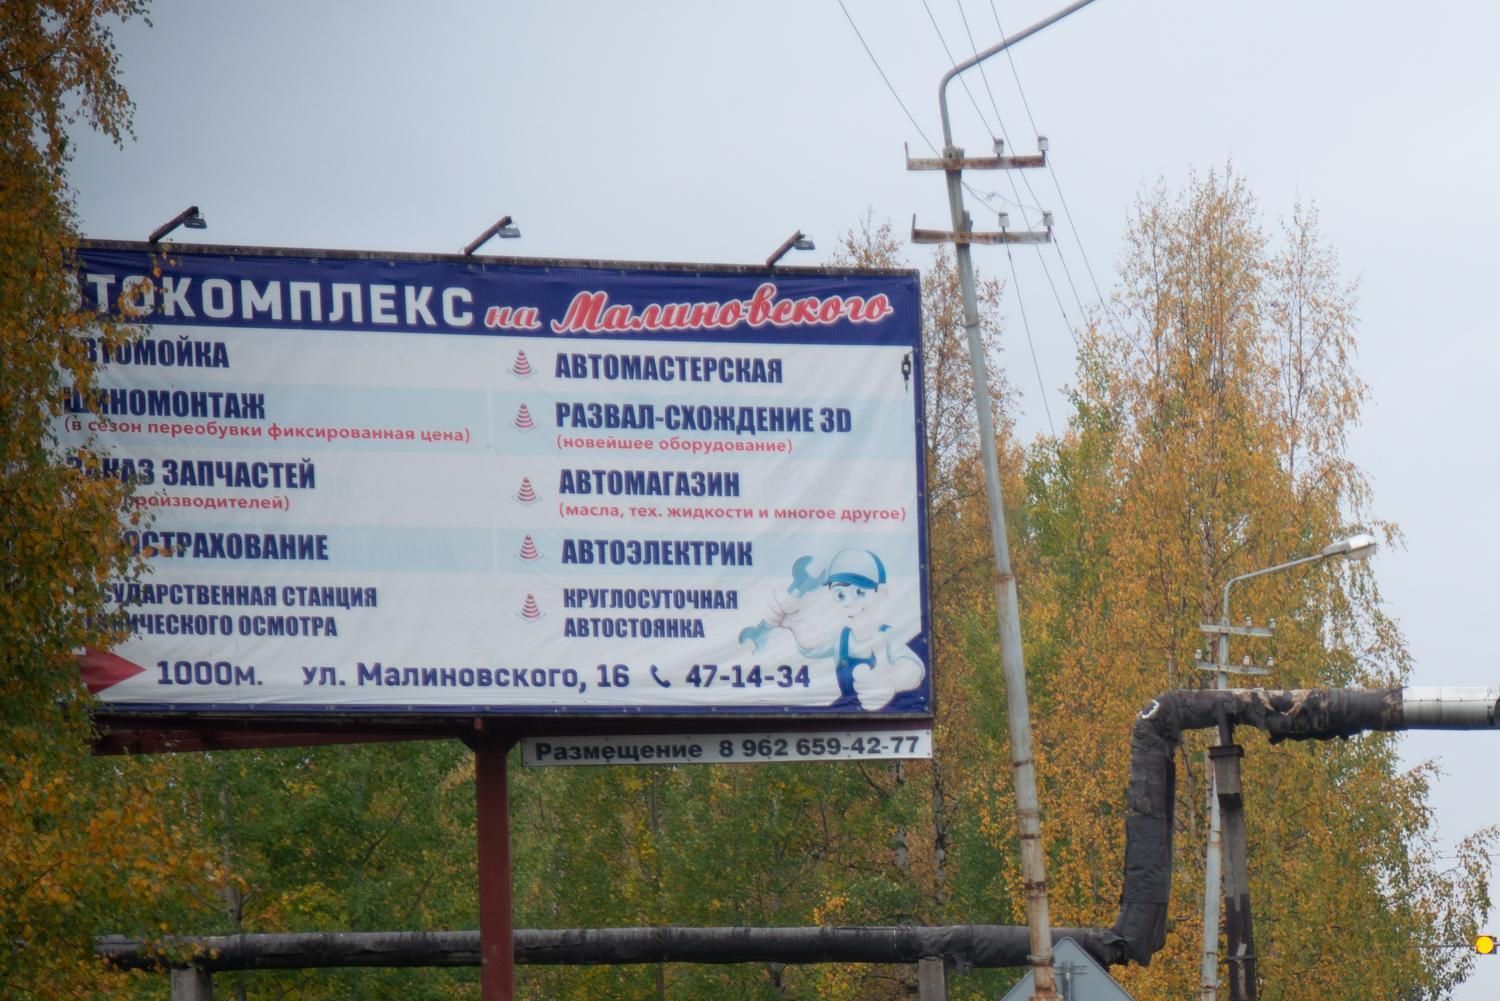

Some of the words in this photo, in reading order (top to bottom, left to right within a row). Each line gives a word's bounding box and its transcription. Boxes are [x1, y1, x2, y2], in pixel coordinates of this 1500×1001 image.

[64, 273, 475, 328] ТОКОМПЛЕКС
[484, 306, 543, 330] на
[551, 282, 894, 333] Малиновского
[86, 335, 230, 369] ВТОМОЙКА
[555, 352, 783, 384] АВТОМАСТЕРСКАЯ
[64, 416, 82, 433] (в
[87, 420, 142, 433] сезон
[147, 421, 263, 439] переобувки
[267, 424, 416, 441] фиксированная
[420, 428, 471, 444] цена)
[555, 401, 815, 435] РАЗВАЛ-СХОЖДЕНИЕ
[820, 406, 852, 433] 3D
[556, 435, 654, 451] (новейшее
[658, 438, 793, 454] оборудование)
[162, 457, 316, 490] ЗАПЧАСТЕЙ
[558, 469, 741, 498] АВТОМАГАЗИН
[558, 502, 624, 519] (масла,
[629, 506, 663, 519] тех.
[666, 507, 754, 520] жидкости
[757, 508, 770, 519] и
[773, 508, 836, 520] многое
[840, 506, 907, 523] другое)
[123, 530, 329, 561] ОСТРАХОВАНИЕ
[561, 539, 753, 567] АВТОЭЛЕКТРИК
[281, 586, 378, 610] СТАНЦИЯ
[563, 587, 739, 610] КРУГЛОСУТОЧНАЯ
[237, 615, 338, 638] ОСМОТРА
[563, 617, 706, 639] АВТОСТОЯНКА
[157, 660, 264, 686] 1000м.
[301, 665, 346, 687] ул.
[356, 662, 588, 694] Малиновского,
[595, 663, 630, 688] 16
[685, 664, 811, 689] 47-14-34
[535, 741, 704, 763] Размещение
[718, 740, 734, 758] 8
[741, 739, 788, 757] 962
[795, 735, 920, 757] 659-42-77
